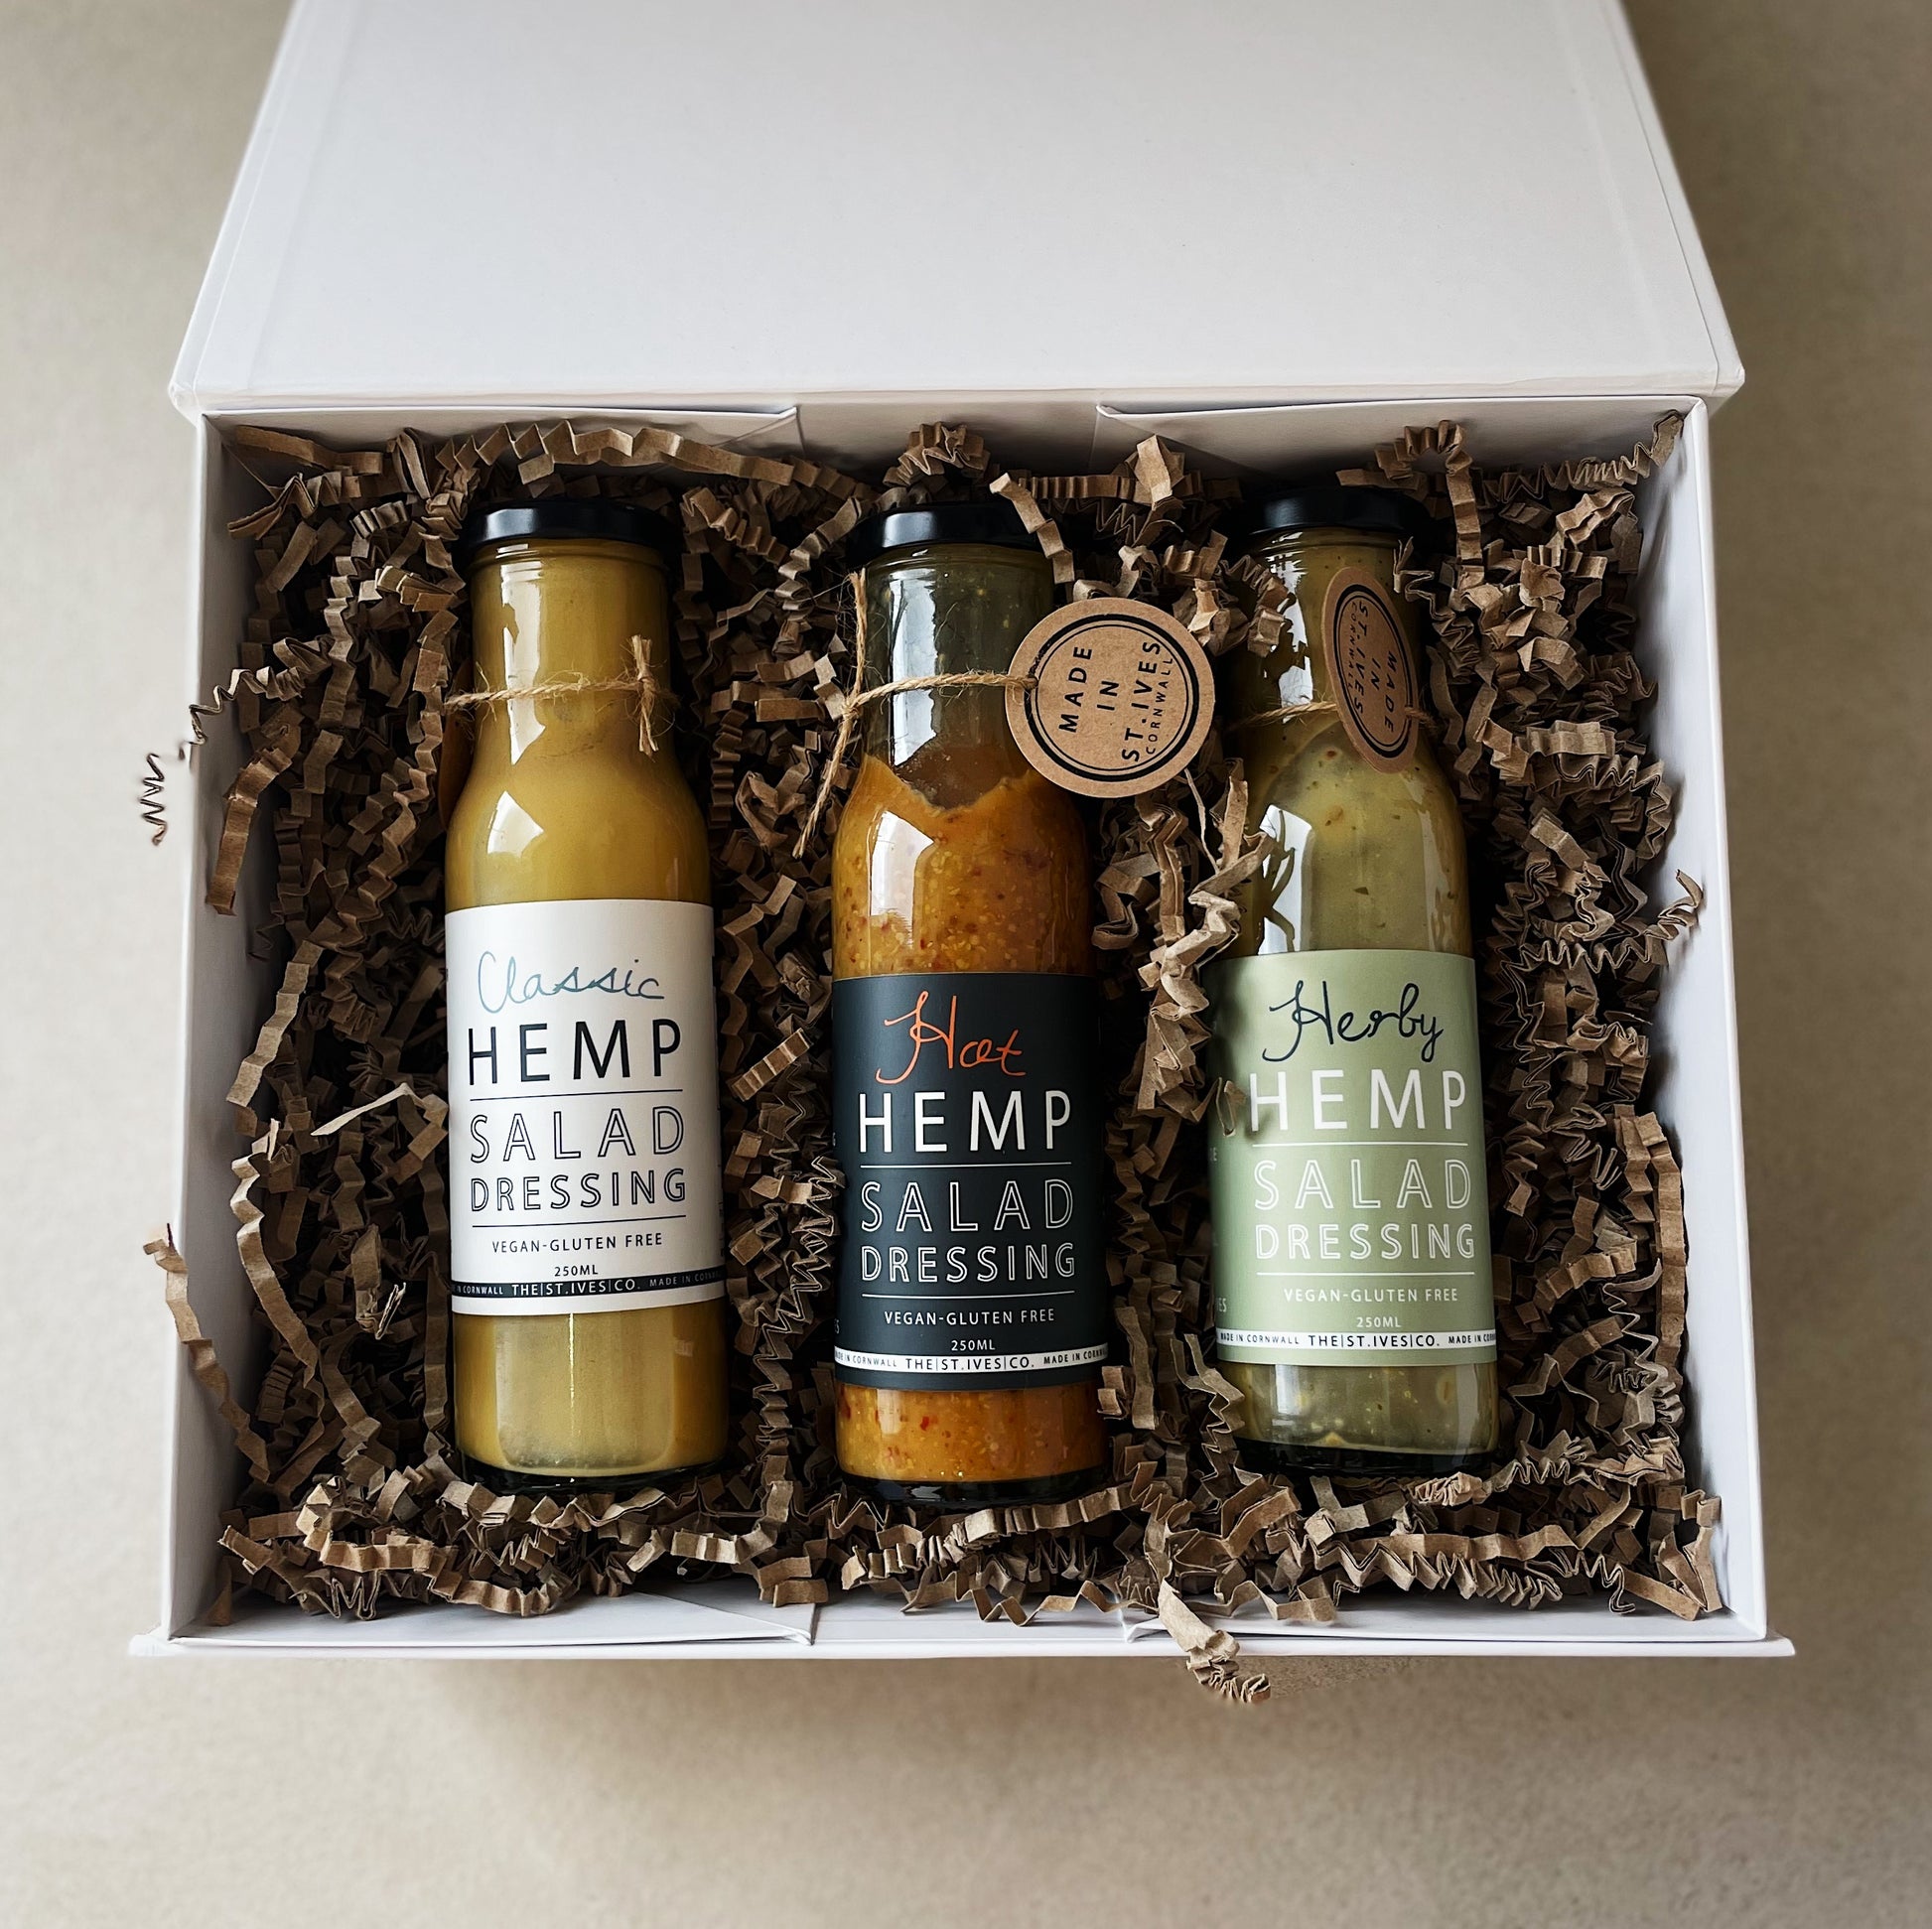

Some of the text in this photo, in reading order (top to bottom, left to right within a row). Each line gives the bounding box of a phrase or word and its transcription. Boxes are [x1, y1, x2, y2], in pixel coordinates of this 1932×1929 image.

[1346, 601, 1358, 690] CORNWALL
[1058, 646, 1092, 733] MADE
[1096, 680, 1120, 711] IN
[1370, 657, 1381, 691] IN
[1384, 650, 1398, 733] MADE
[1145, 657, 1173, 755] CORNWALL
[479, 950, 665, 1014] Classic
[875, 990, 1027, 1085] Hot
[1262, 979, 1445, 1062] Herby
[468, 1019, 682, 1086] HEMP
[858, 1090, 1072, 1153] HEMP
[1249, 1068, 1466, 1132] HEMP
[469, 1105, 685, 1165] SALAD
[471, 1168, 686, 1212] DRESSING
[861, 1178, 1073, 1232] SALAD
[1254, 1159, 1471, 1211] SALAD
[491, 1232, 663, 1254] VEGAN-GLUTEN FREE
[861, 1242, 1076, 1283] DRESSING
[1255, 1222, 1475, 1260] DRESSING
[463, 1285, 504, 1296] CORNWALL
[649, 1276, 677, 1288] MADE
[553, 1264, 599, 1278] 250ML
[1284, 1287, 1458, 1303] VEGAN-GLUTEN FREE
[884, 1309, 1055, 1326] VEGAN-GLUTEN FREE
[1247, 1333, 1300, 1344] CORNWALL
[1448, 1334, 1472, 1344] MADE
[1356, 1315, 1402, 1328] 250ML
[853, 1354, 897, 1367] CORNWALL
[1043, 1353, 1069, 1365] MADE
[1072, 1352, 1080, 1362] IN
[950, 1338, 996, 1352] 250ML
